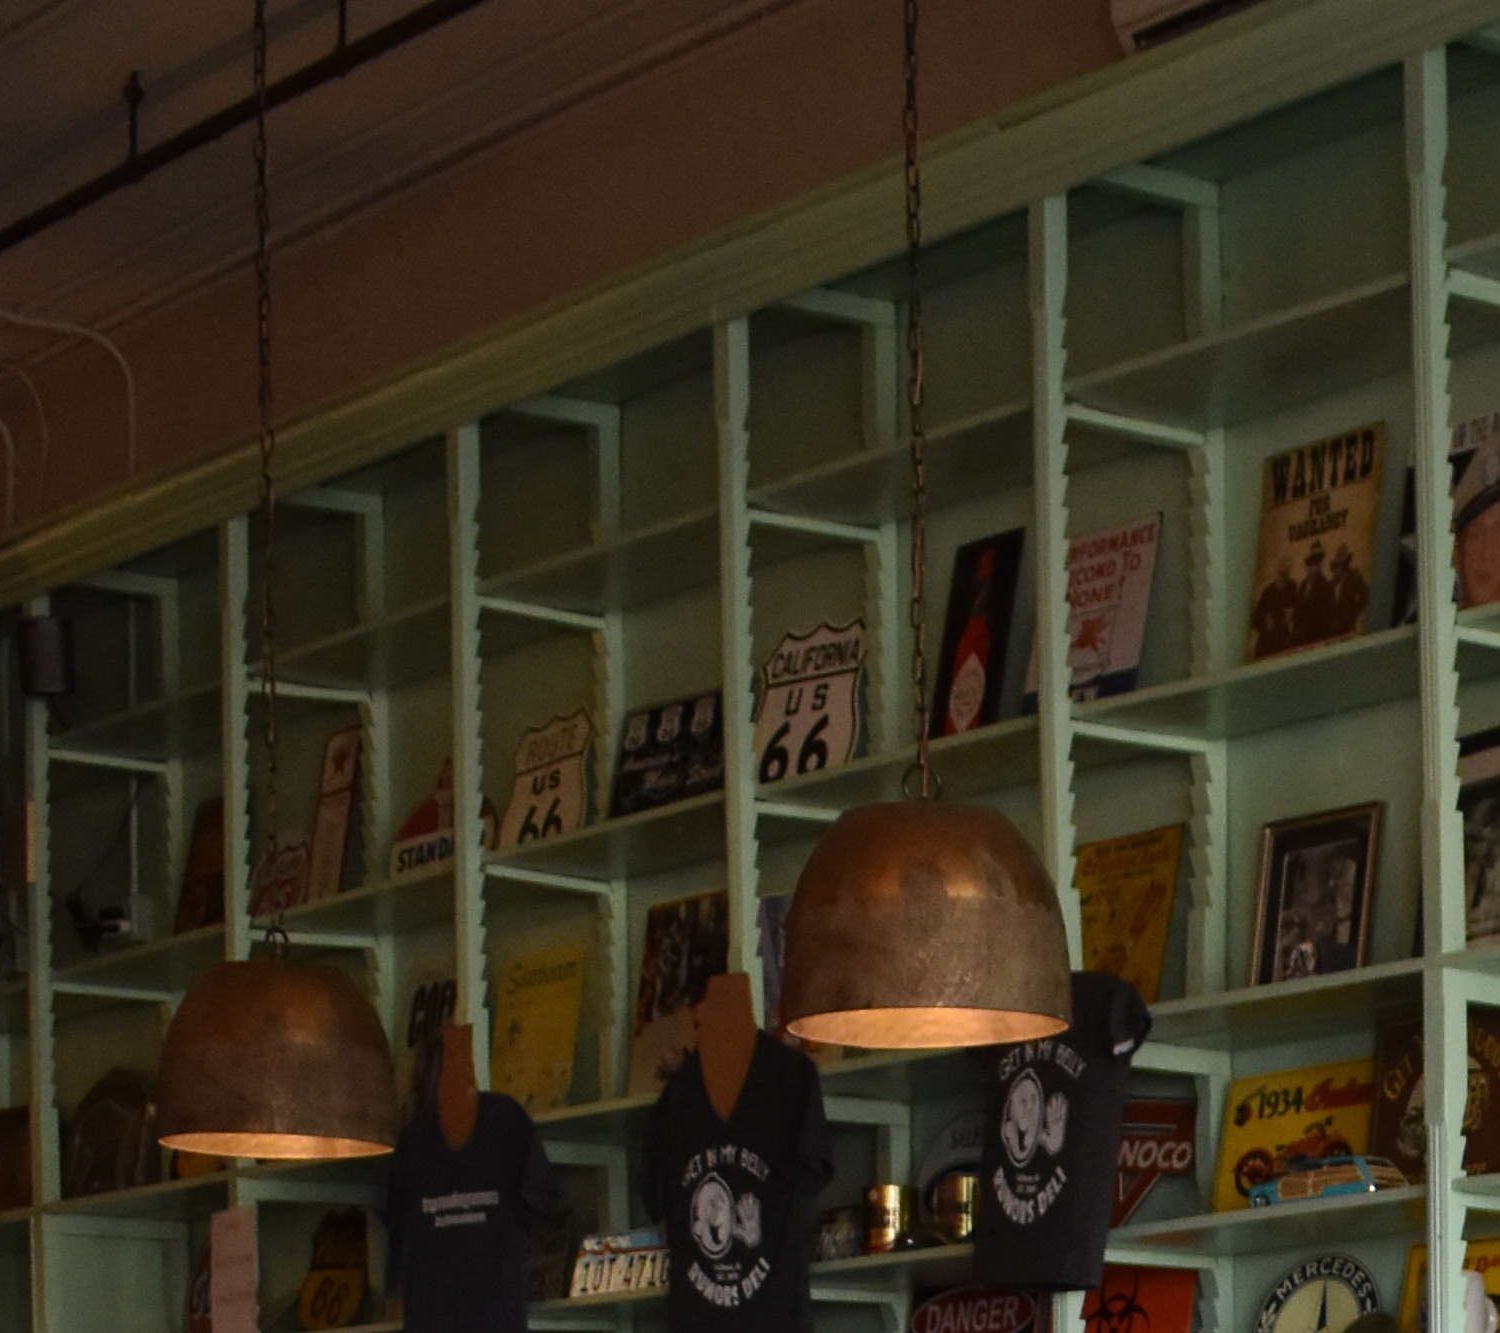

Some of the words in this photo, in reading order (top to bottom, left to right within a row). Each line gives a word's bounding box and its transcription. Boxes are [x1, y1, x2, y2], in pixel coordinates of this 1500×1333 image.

[1270, 432, 1376, 505] WANTED
[769, 636, 863, 681] CALIFORNIA
[525, 721, 582, 766] ROUTE
[760, 716, 831, 786] 66
[531, 769, 562, 793] US
[1257, 1085, 1303, 1120] 1934
[1117, 1139, 1193, 1170] NOCO
[1276, 1258, 1372, 1302] MERCEDES
